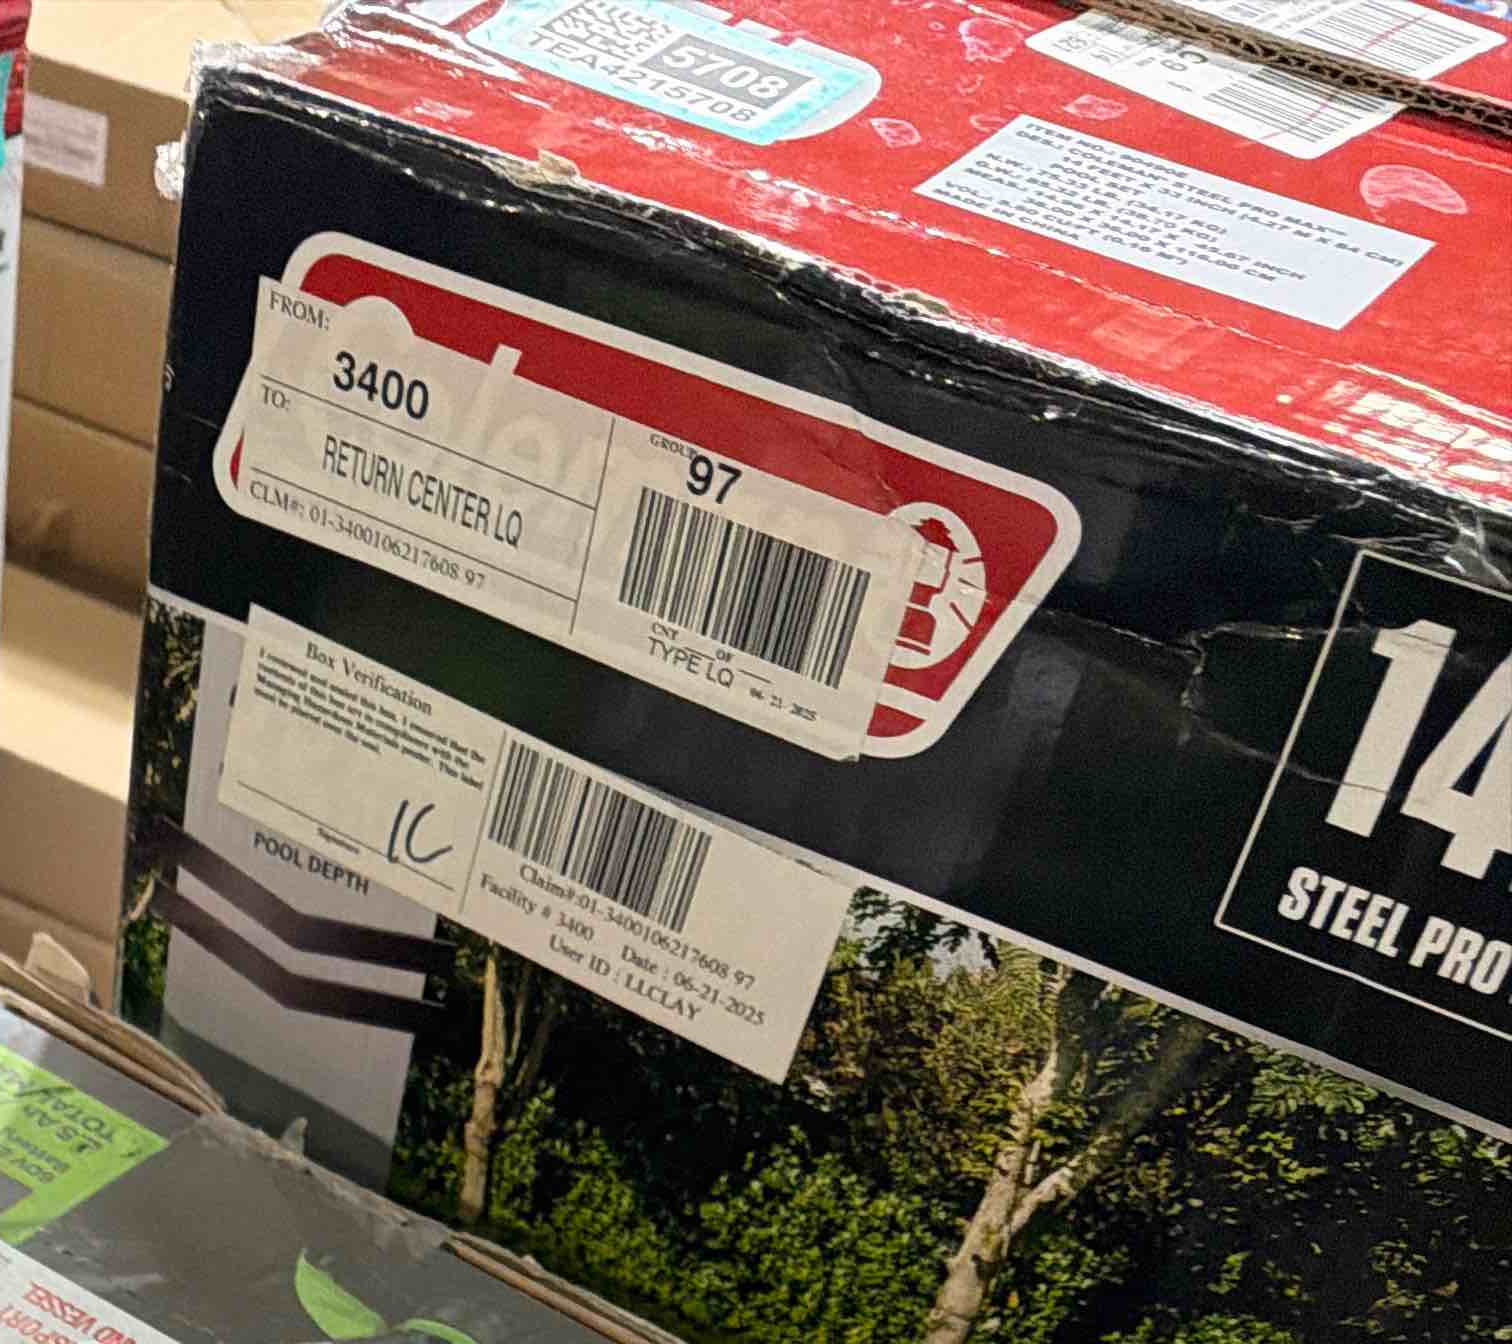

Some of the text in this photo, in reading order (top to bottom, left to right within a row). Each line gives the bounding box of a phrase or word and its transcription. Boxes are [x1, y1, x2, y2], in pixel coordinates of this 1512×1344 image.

[529, 31, 758, 123] TEA4215708
[660, 46, 790, 100] 5708
[1048, 163, 1145, 196] POOL SET
[1086, 164, 1136, 183] FEET
[1185, 196, 1237, 215] INCH
[1170, 180, 1236, 204] STEEL
[1237, 201, 1280, 217] PRO
[931, 187, 988, 209] MADE
[1016, 216, 1082, 240] CHINA
[1252, 260, 1307, 281] INCH
[267, 289, 331, 332] FROM:
[261, 384, 290, 413] TO:
[330, 348, 431, 423] 3400
[321, 434, 525, 553] RETURN CENTER LQ
[686, 454, 743, 504] 97
[249, 478, 305, 519] CLM#:
[461, 567, 485, 593] 97
[304, 641, 434, 716] Box Verification
[647, 635, 735, 689] TYPE LQ
[252, 828, 371, 896] POOL DEPTH
[479, 872, 536, 915] Facility
[555, 910, 595, 943] 3400
[1278, 864, 1507, 998] STEEL PRO
[548, 933, 585, 966] User
[589, 953, 611, 978] ID
[733, 969, 755, 991] 97
[620, 943, 659, 975] Date
[673, 970, 766, 1028] 06-21-2025
[21, 1279, 98, 1331] VESSEL
